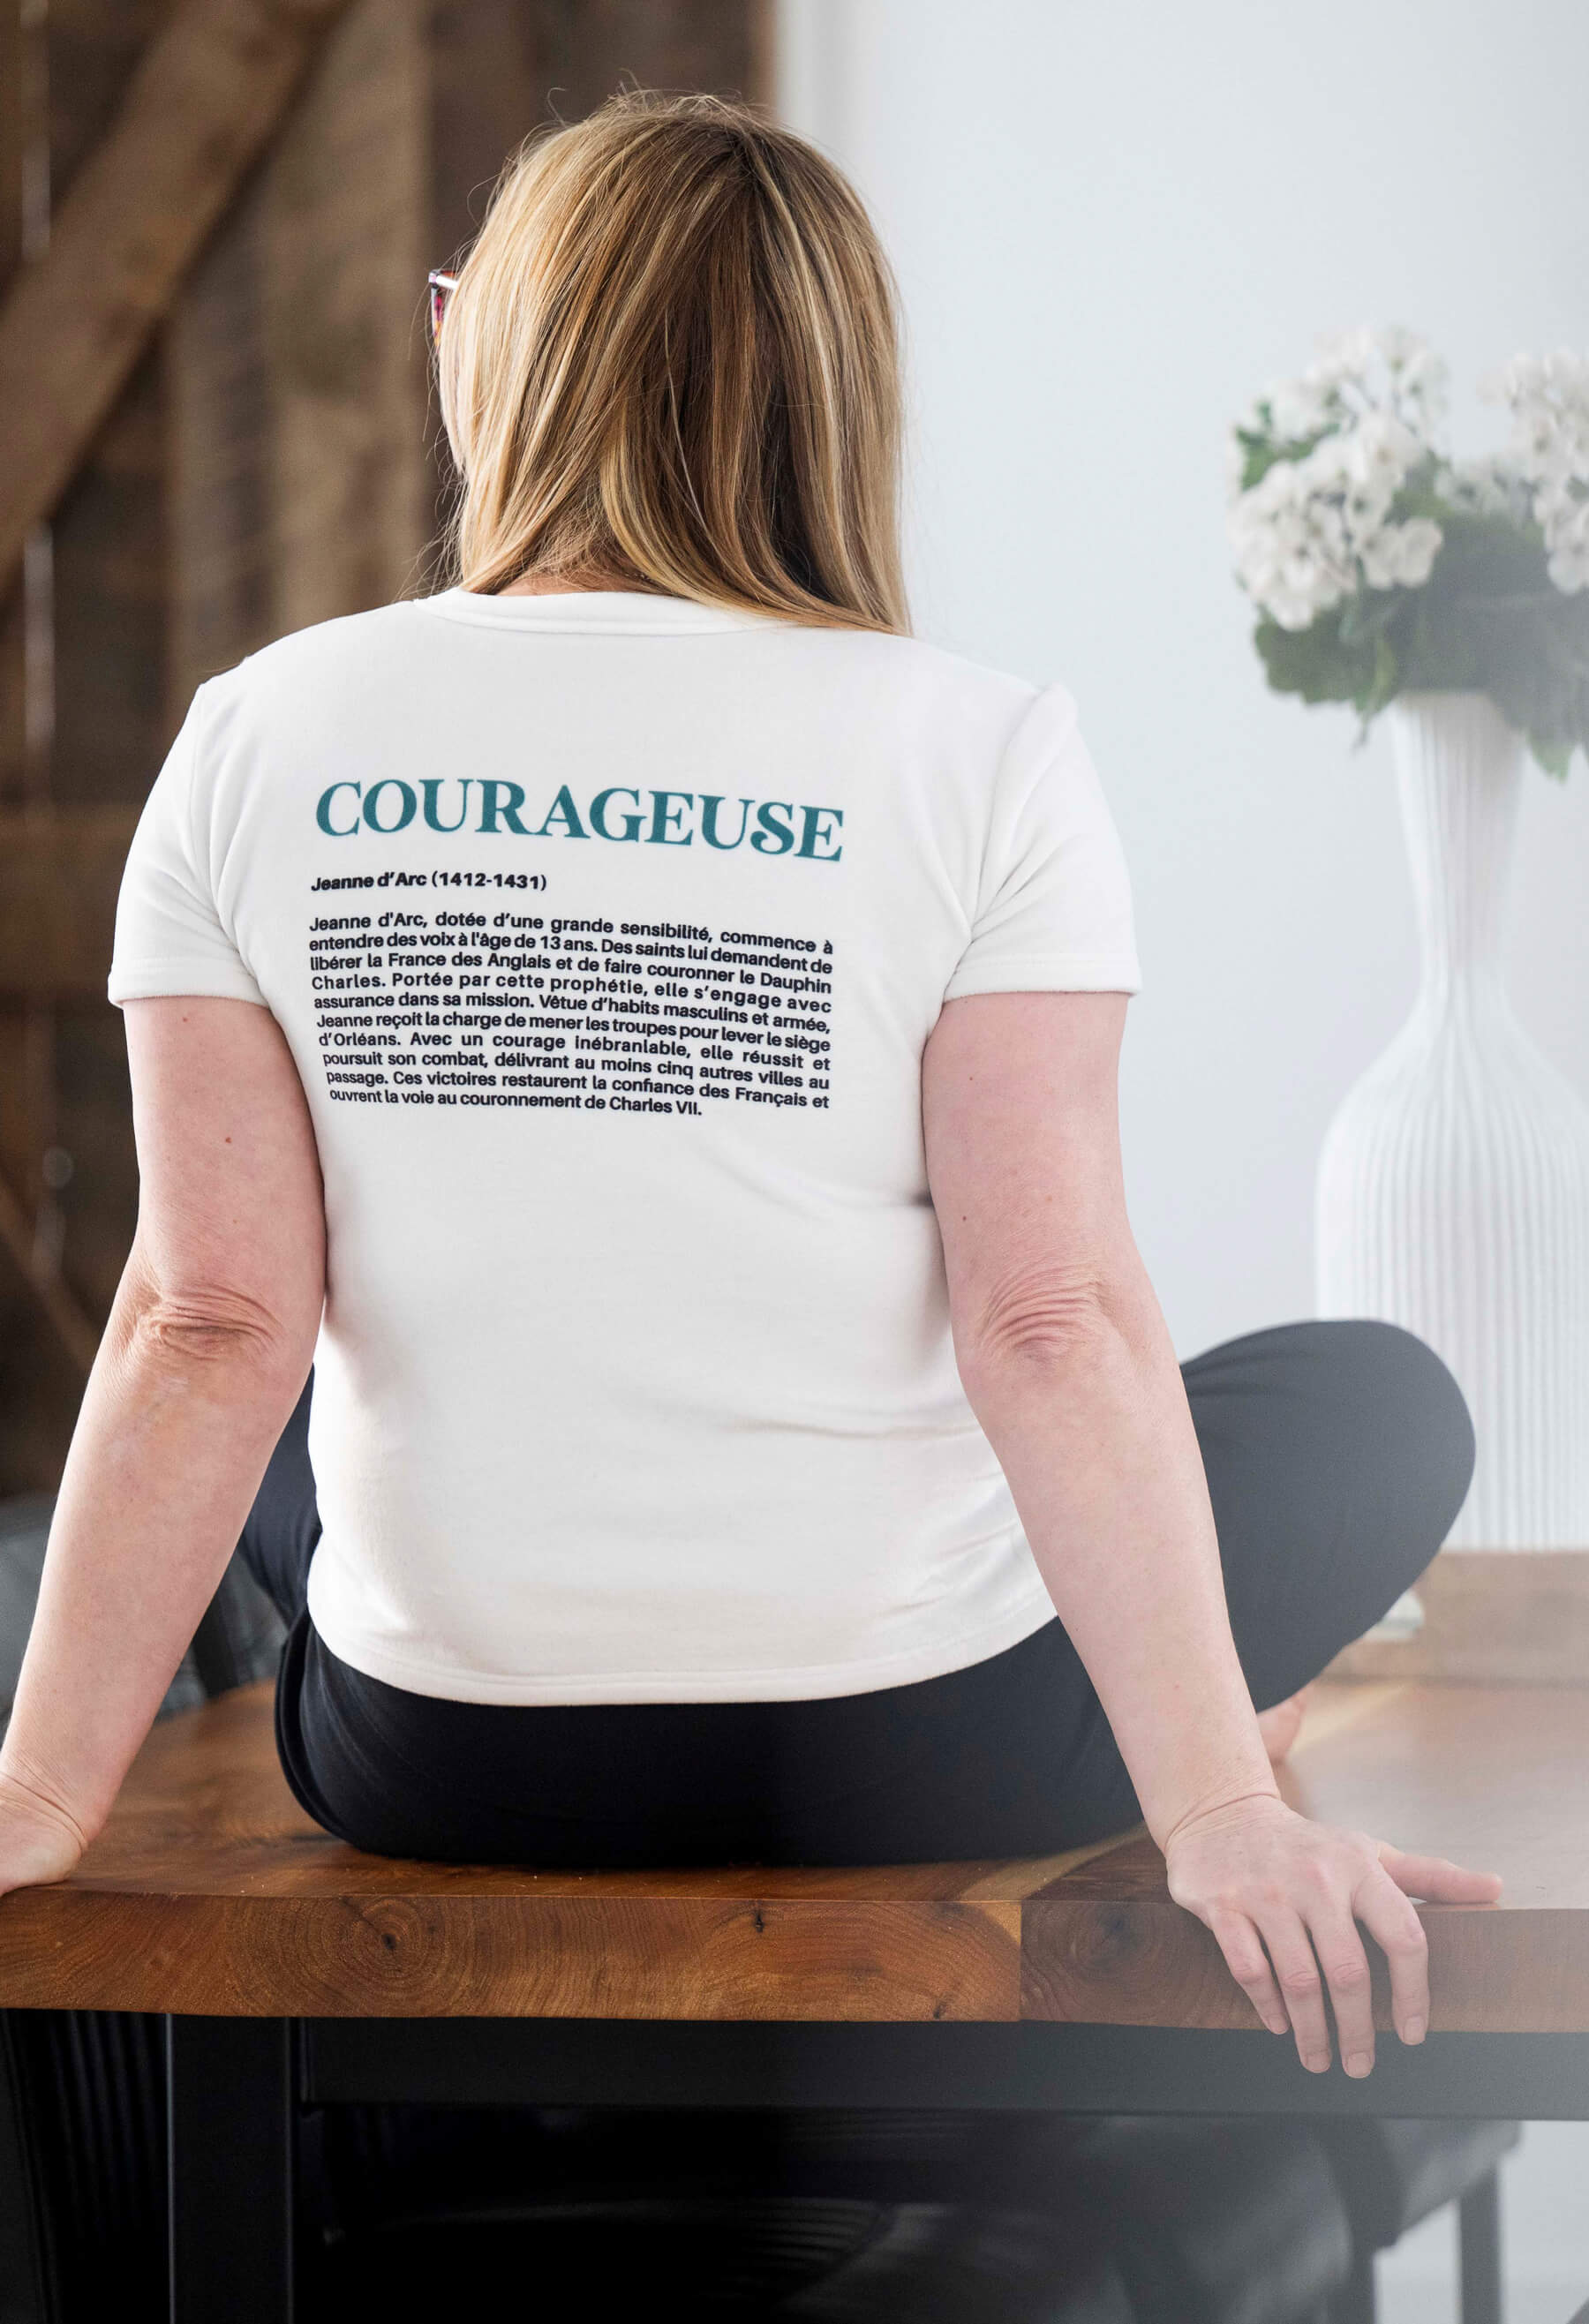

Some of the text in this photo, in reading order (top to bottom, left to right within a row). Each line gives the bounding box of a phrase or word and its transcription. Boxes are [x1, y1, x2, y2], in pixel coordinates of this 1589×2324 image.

[316, 779, 843, 861] COURAGEUSE
[311, 876, 374, 891] Jeanne
[432, 870, 546, 891] (1412-1431)
[309, 917, 371, 931] Jeanne
[435, 912, 486, 927] dotée
[551, 918, 614, 934] grande
[621, 923, 712, 944] sensibilité,
[720, 931, 817, 952] commence
[823, 940, 832, 954] à
[309, 933, 384, 951] entendre
[387, 932, 418, 947] des
[419, 931, 456, 946] voix
[458, 932, 468, 946] à
[514, 934, 536, 949] de
[540, 936, 561, 950] 13
[563, 939, 598, 952] ans.
[601, 939, 633, 954] Des
[635, 942, 685, 959] saints
[688, 944, 708, 960] lui
[711, 947, 808, 972] demandent
[810, 959, 832, 974] de
[310, 951, 832, 994] libérer la France des Anglais et de faire couronner le Dauphin
[312, 974, 386, 990] Charles.
[392, 972, 453, 987] Portée
[459, 975, 491, 989] par
[495, 974, 545, 989] cette
[551, 977, 648, 997] prophétie,
[654, 982, 689, 997] elle
[787, 998, 832, 1013] avec
[314, 996, 395, 1009] assurance
[398, 991, 440, 1006] dans
[442, 995, 461, 1006] sa
[466, 992, 534, 1008] mission.
[539, 994, 588, 1011] Vêtue
[664, 1005, 748, 1024] masculins
[752, 1012, 769, 1026] et
[772, 1016, 830, 1034] armée,
[317, 1011, 831, 1054] Jeanne reçoit la charge de mener les troupes pour lever le siège
[323, 1051, 829, 1089] poursuit son combat, délivrant au moins cinq autres villes au
[410, 1032, 452, 1046] Avec
[461, 1035, 483, 1046] un
[493, 1035, 566, 1052] courage
[576, 1035, 691, 1059] inébranlable,
[700, 1045, 734, 1061] elle
[742, 1050, 804, 1069] réussit
[813, 1058, 831, 1071] et
[327, 1071, 830, 1109] passage. Ces victoires restaurent la confiance des Français et
[329, 1089, 702, 1116] ouvrent la voie au couronnement de Charles VII.
